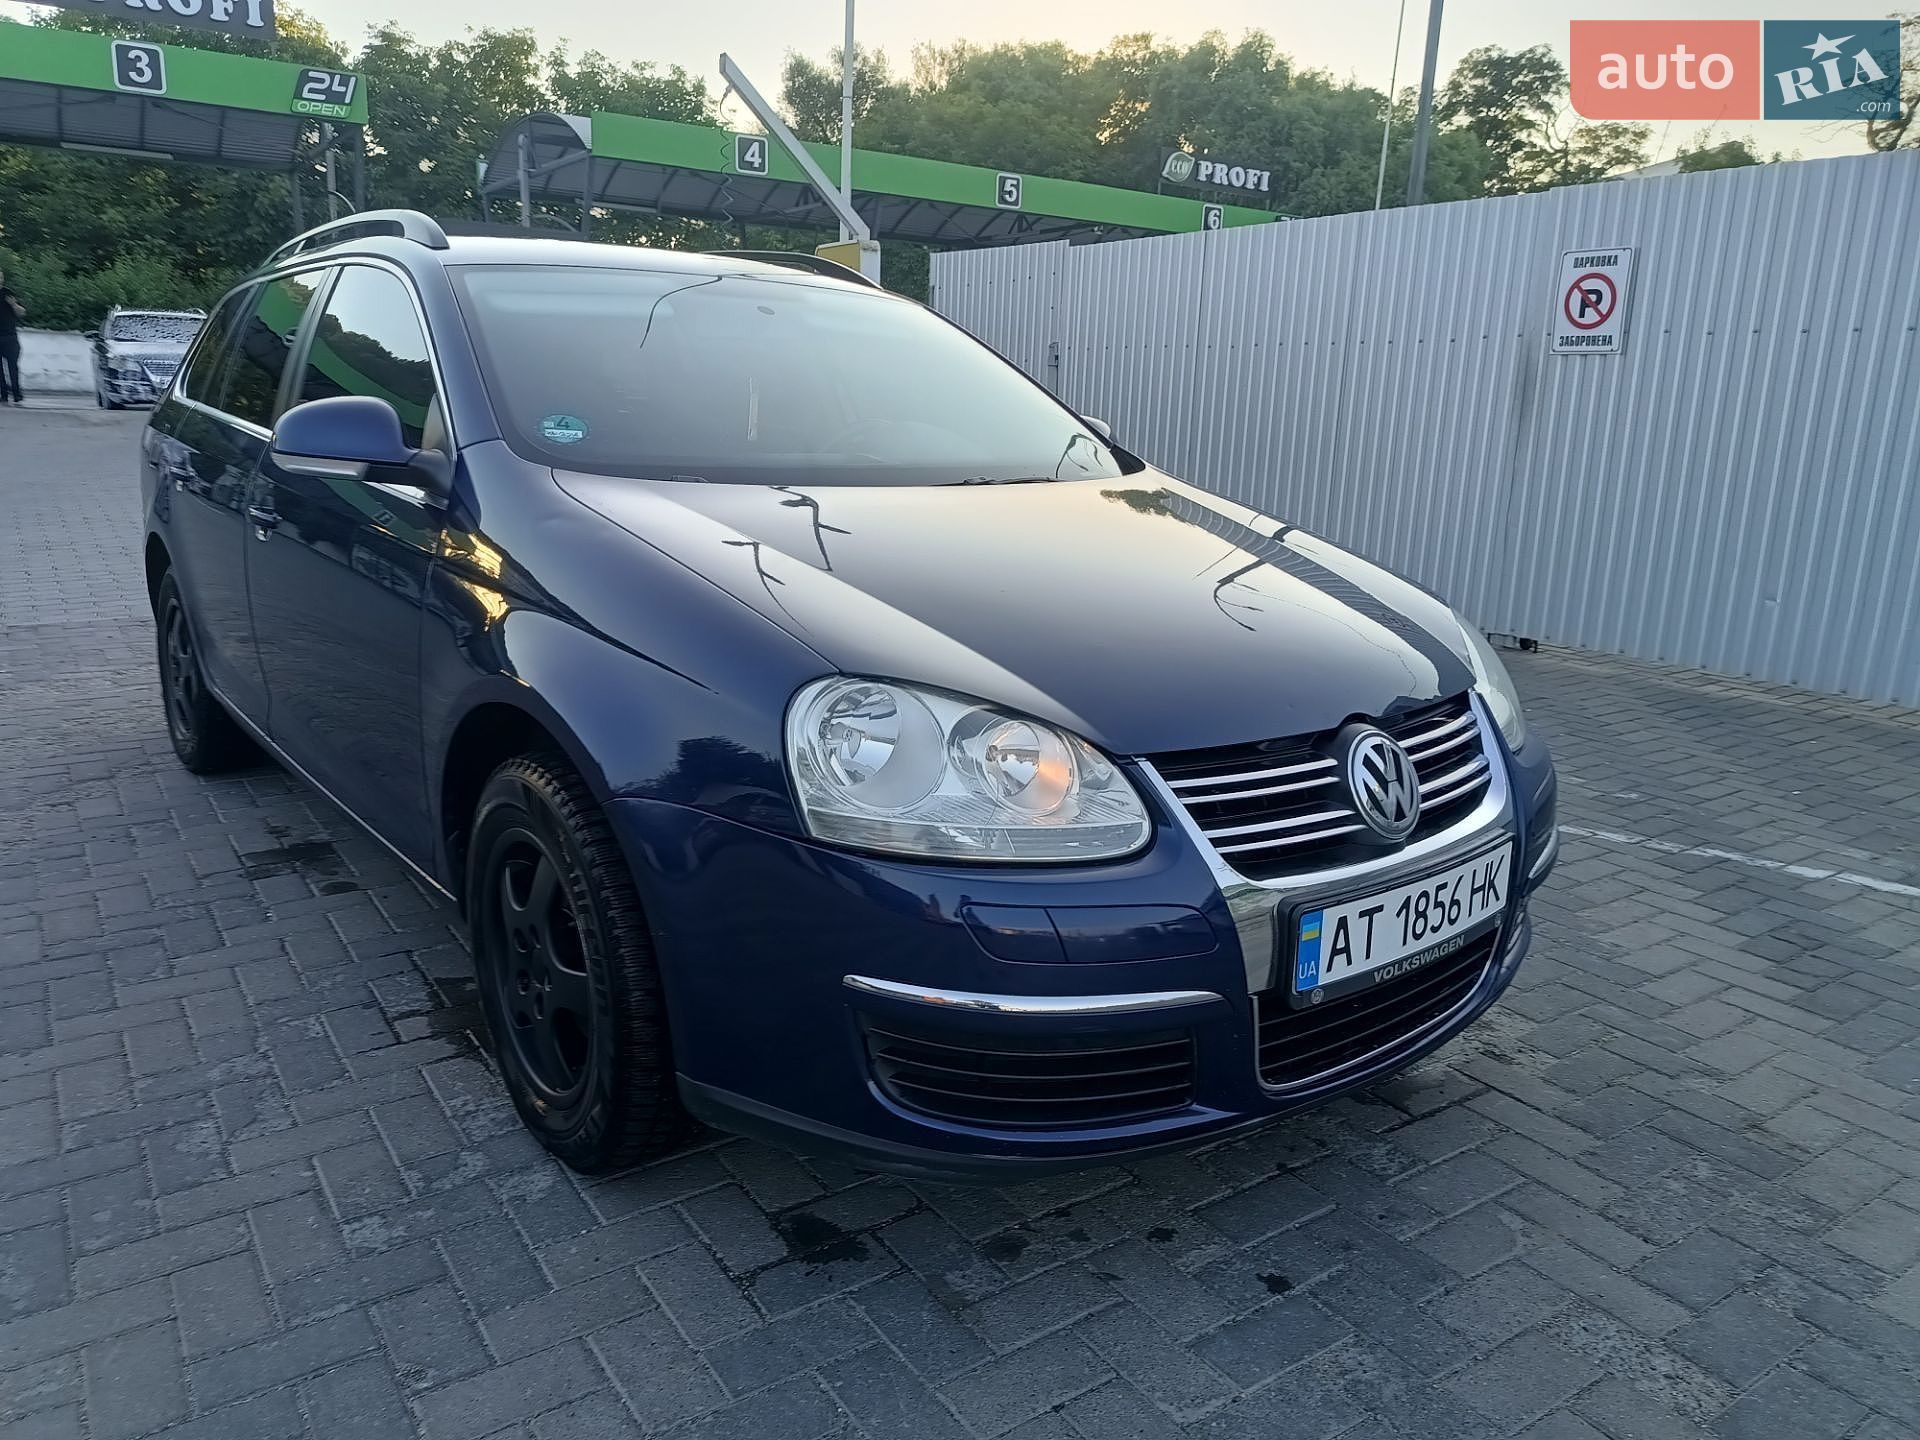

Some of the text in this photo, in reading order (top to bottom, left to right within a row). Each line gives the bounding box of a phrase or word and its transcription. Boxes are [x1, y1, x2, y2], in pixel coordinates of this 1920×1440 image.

[127, 50, 152, 83] 3
[302, 71, 356, 103] 24
[297, 101, 346, 116] OPEN
[743, 141, 762, 168] 4
[1197, 160, 1271, 191] PROFI
[1002, 179, 1018, 203] 5
[1207, 209, 1220, 230] 6
[1573, 255, 1618, 268] ПАРКОВКА
[1559, 335, 1613, 347] ЗАБОРОНЕНА
[1326, 854, 1505, 973] AT 1856 HK
[1298, 961, 1317, 979] UA
[1373, 935, 1466, 983] VOLKSWAGEN
